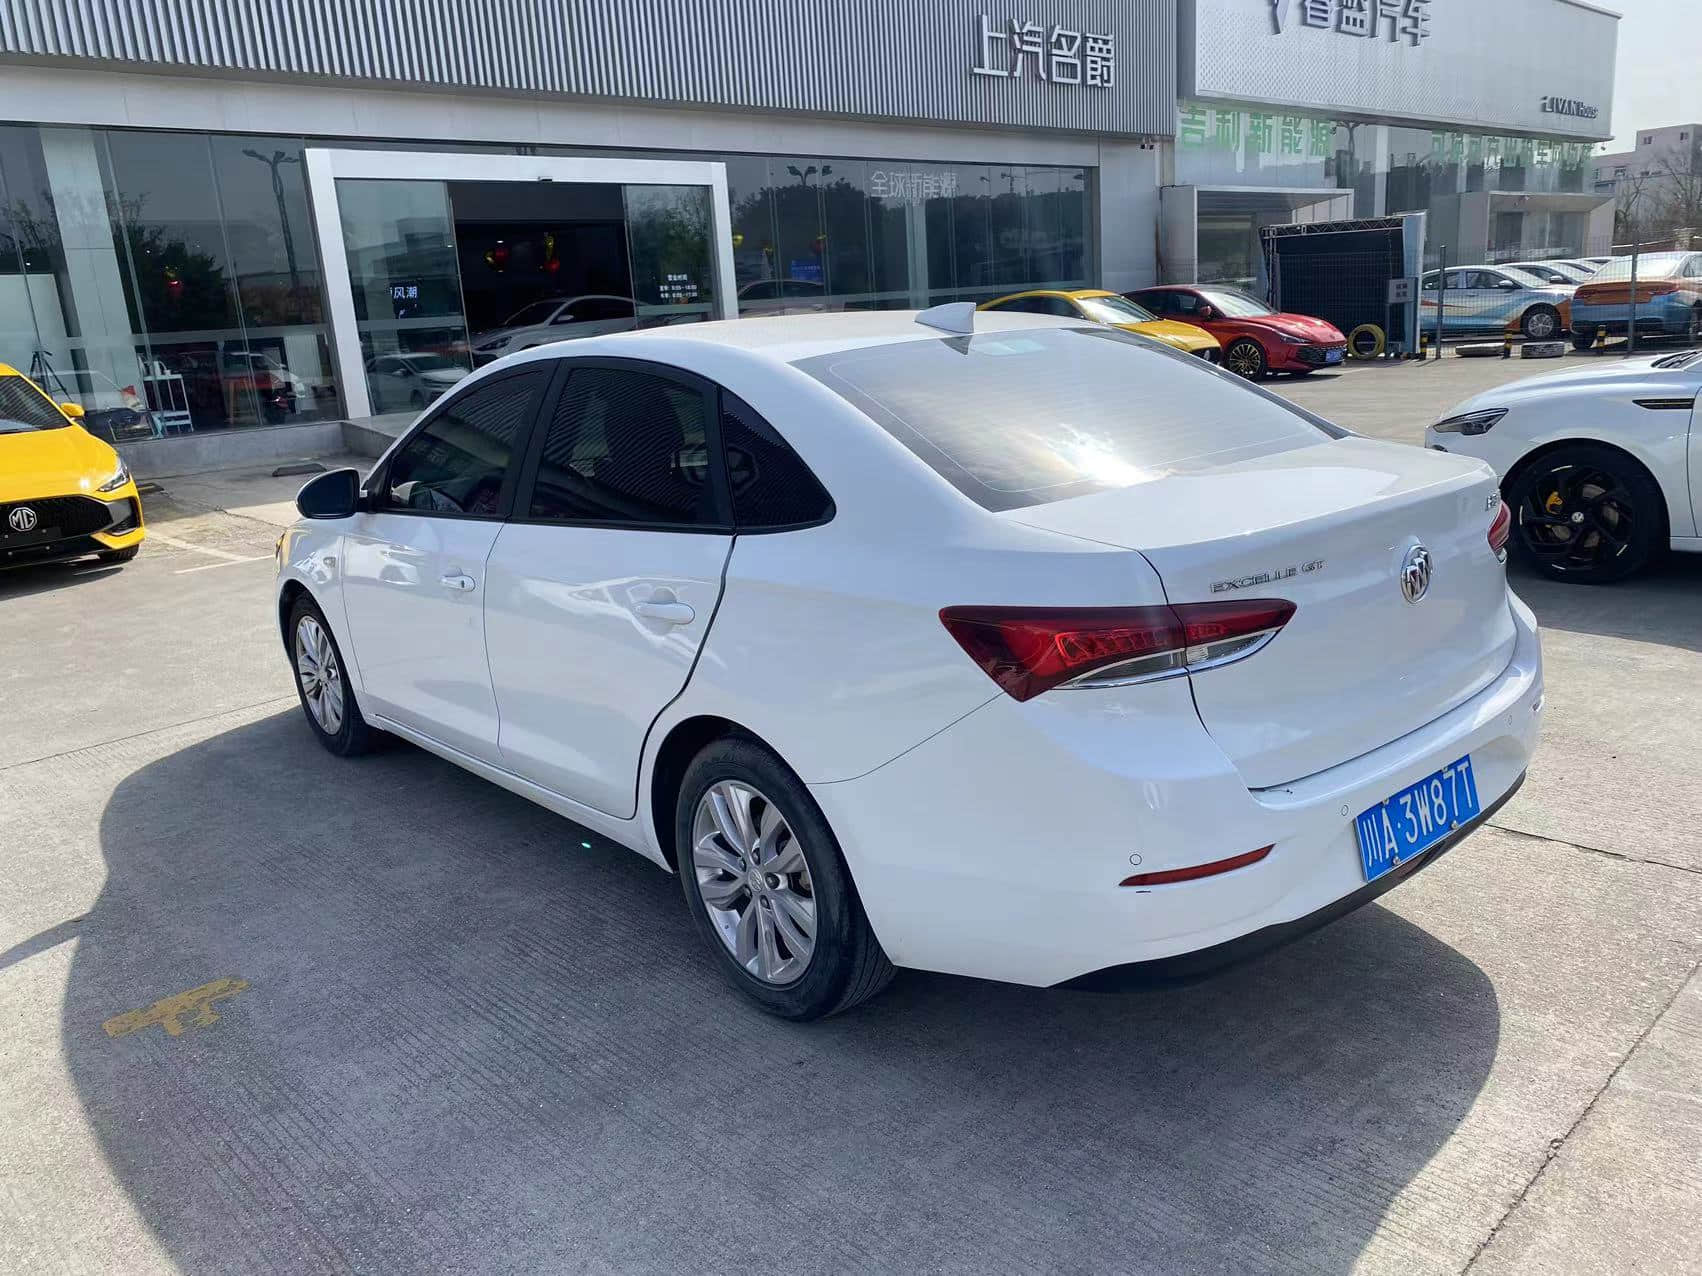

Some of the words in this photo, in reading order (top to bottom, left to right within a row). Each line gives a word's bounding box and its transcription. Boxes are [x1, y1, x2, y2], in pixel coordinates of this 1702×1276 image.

[972, 14, 1115, 87] 上汽名爵
[11, 508, 36, 530] MG
[1210, 567, 1297, 593] EXCELLE
[1301, 559, 1326, 573] GT
